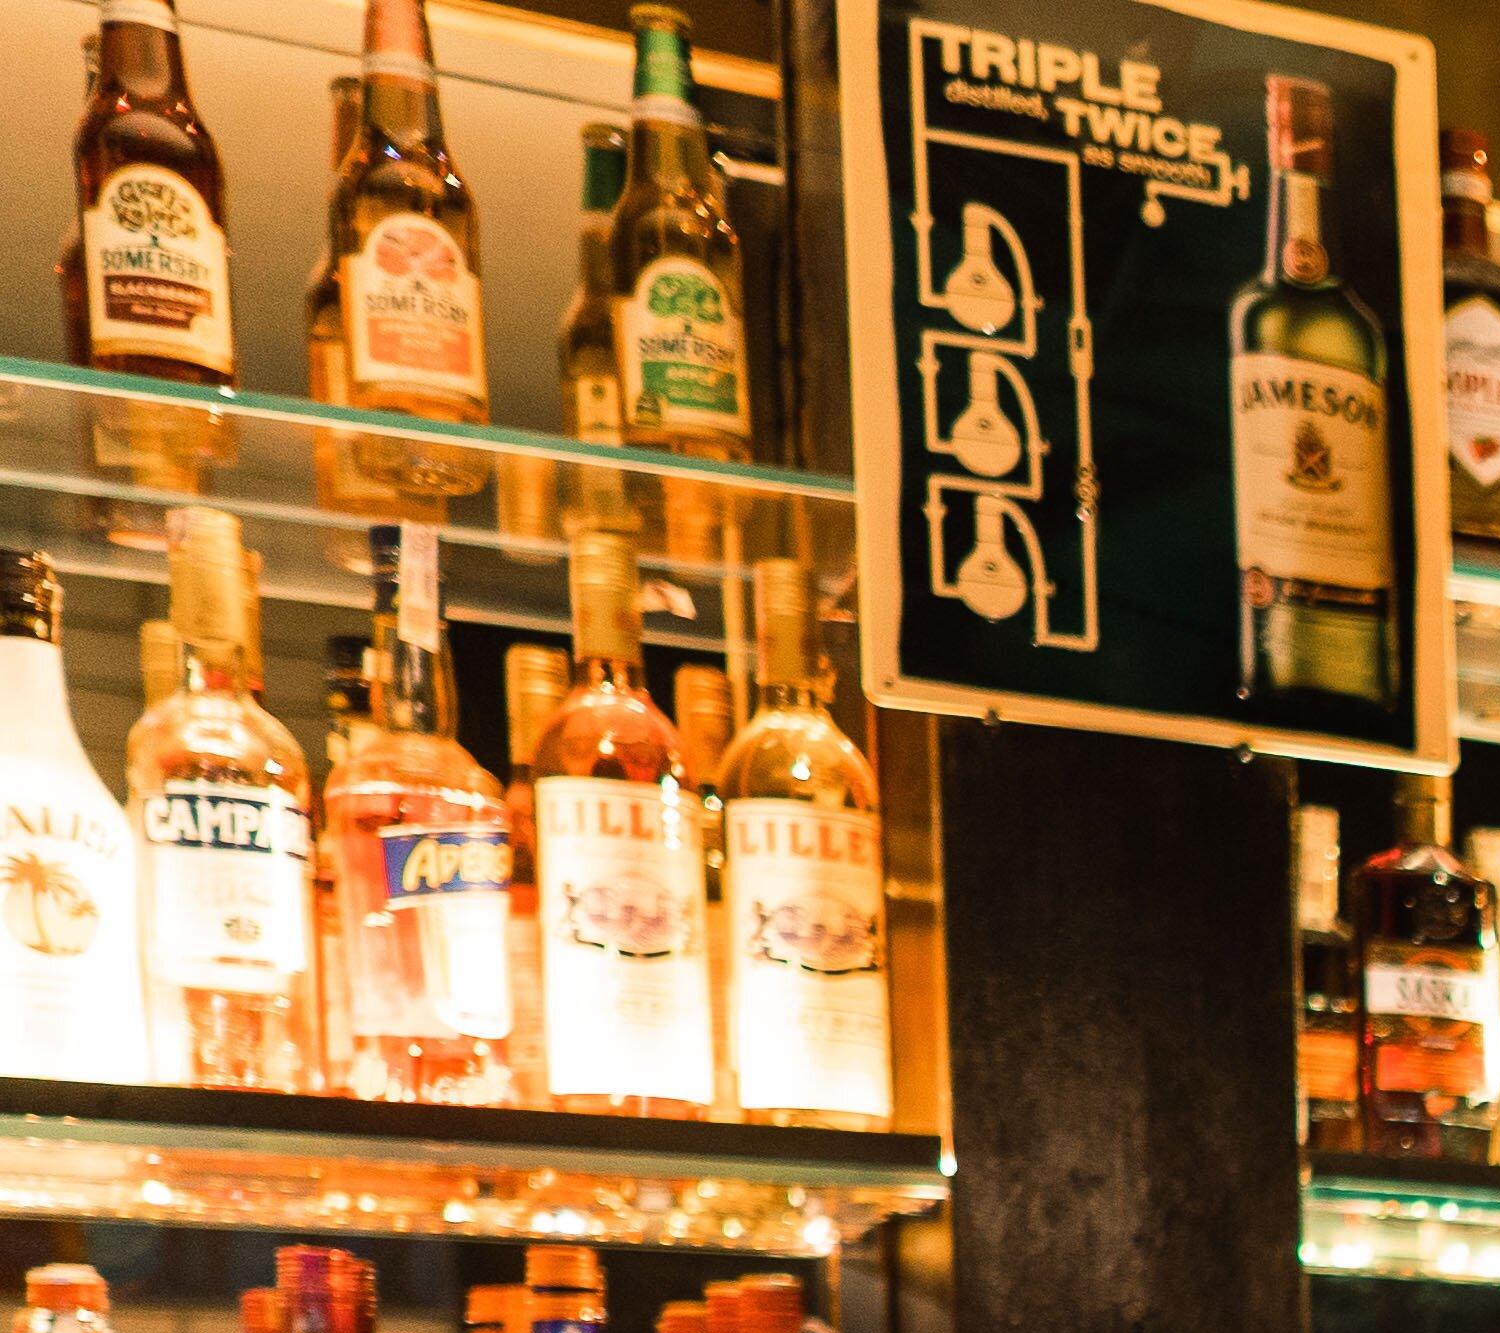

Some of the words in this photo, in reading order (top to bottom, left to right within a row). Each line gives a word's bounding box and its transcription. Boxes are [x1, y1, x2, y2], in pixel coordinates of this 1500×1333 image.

[941, 24, 1163, 113] TRIPLE
[1055, 97, 1222, 165] TWICE
[1241, 378, 1379, 429] JAMESON
[145, 796, 310, 854] CAMPA
